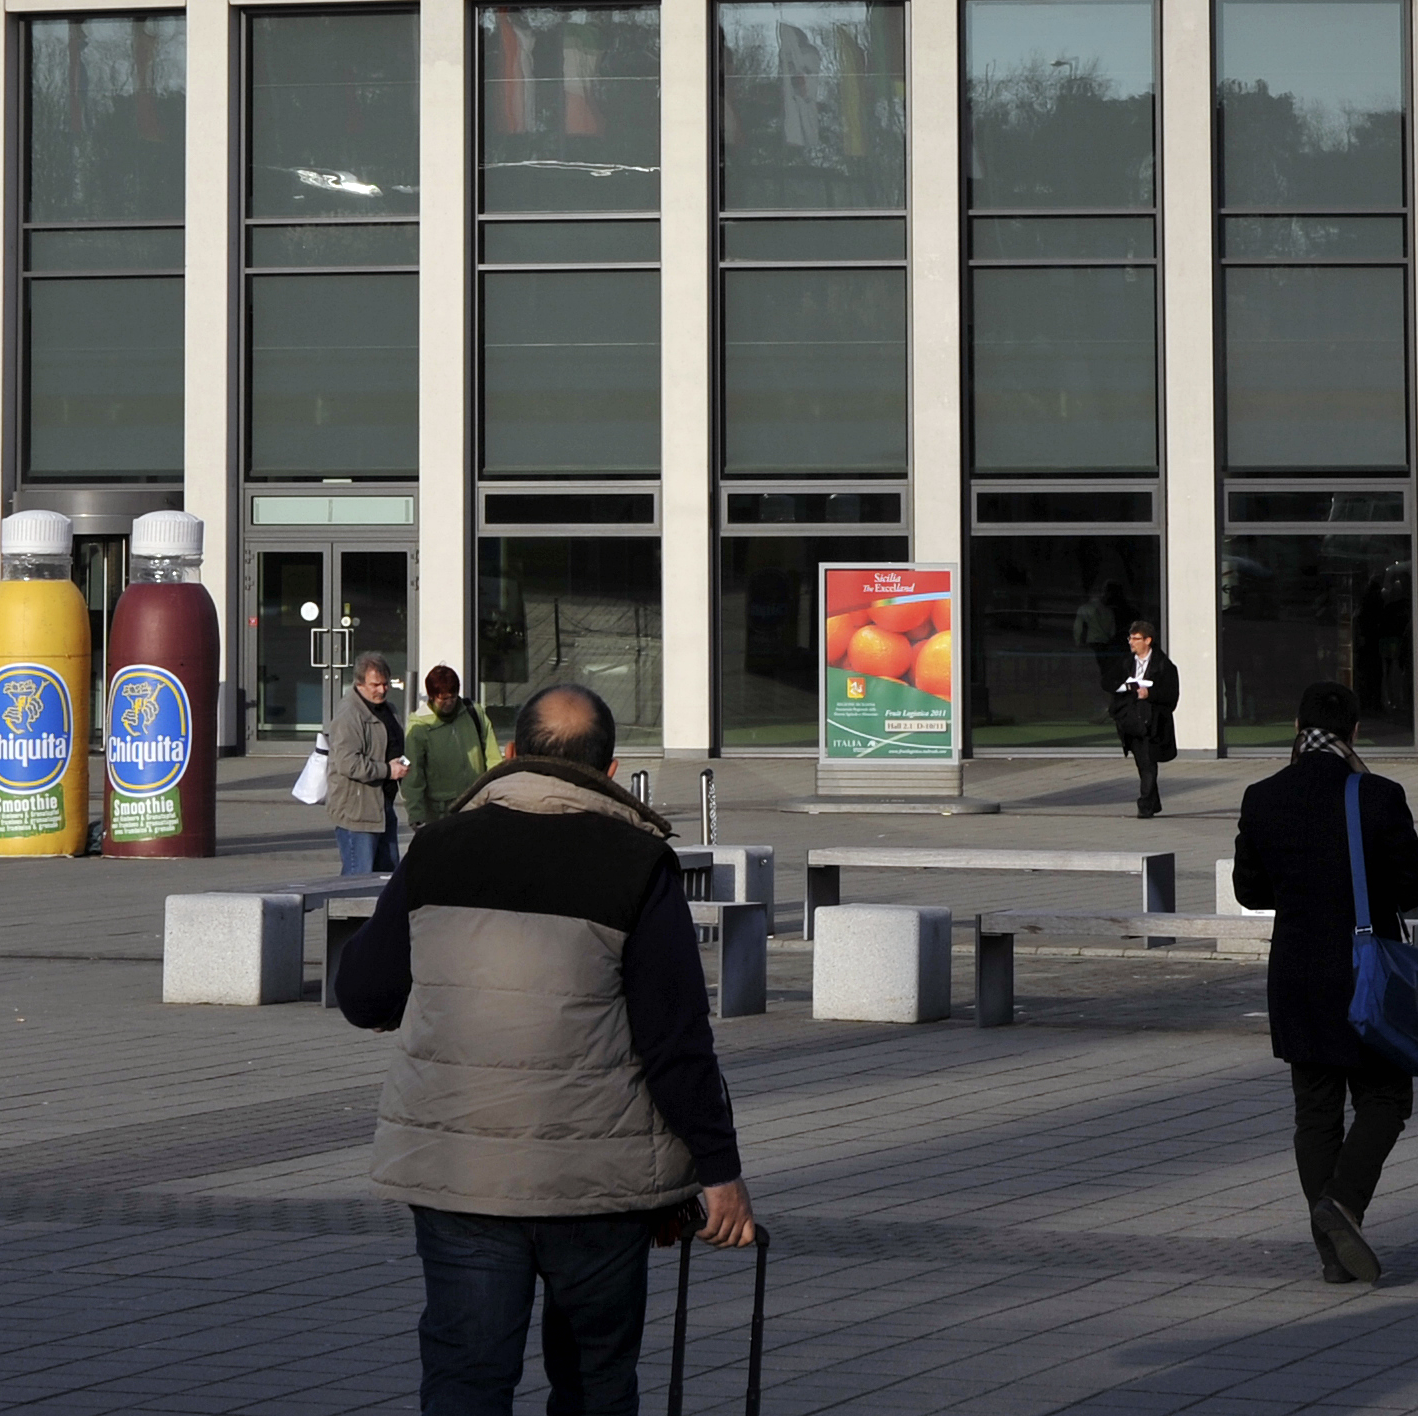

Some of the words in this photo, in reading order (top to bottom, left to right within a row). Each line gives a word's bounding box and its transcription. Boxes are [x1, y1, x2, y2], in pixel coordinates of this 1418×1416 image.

[108, 735, 184, 770] Chiquita
[833, 739, 862, 747] ITALIA
[114, 796, 174, 816] Smoothie
